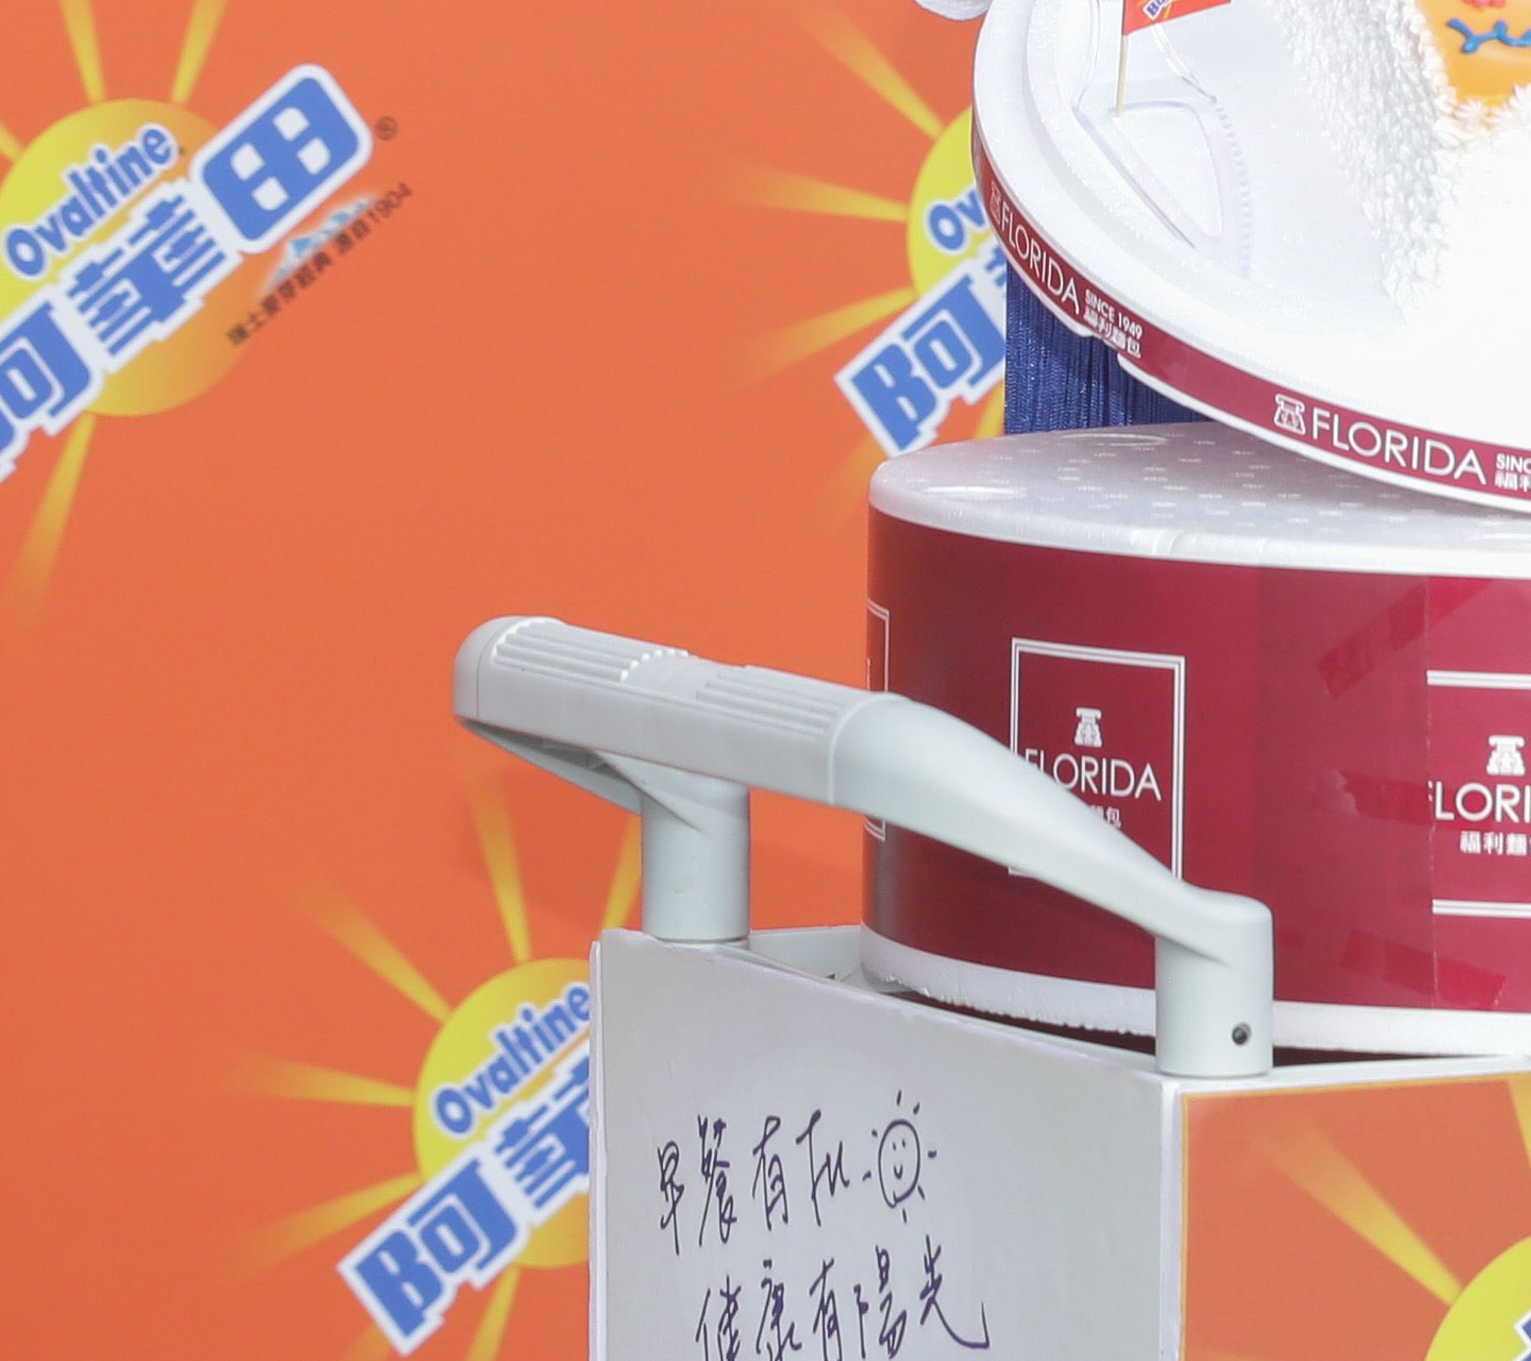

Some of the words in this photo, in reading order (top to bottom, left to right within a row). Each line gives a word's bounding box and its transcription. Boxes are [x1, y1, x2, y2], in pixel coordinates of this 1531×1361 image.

[5, 128, 174, 277] Ovaltine
[1001, 201, 1080, 315] FLORIDA
[1085, 289, 1115, 322] SINCE
[1118, 312, 1143, 339] 1949
[1312, 407, 1487, 485] FLORIDA
[437, 985, 589, 1131] Ovaltine
[354, 1055, 589, 1339] 阿華
